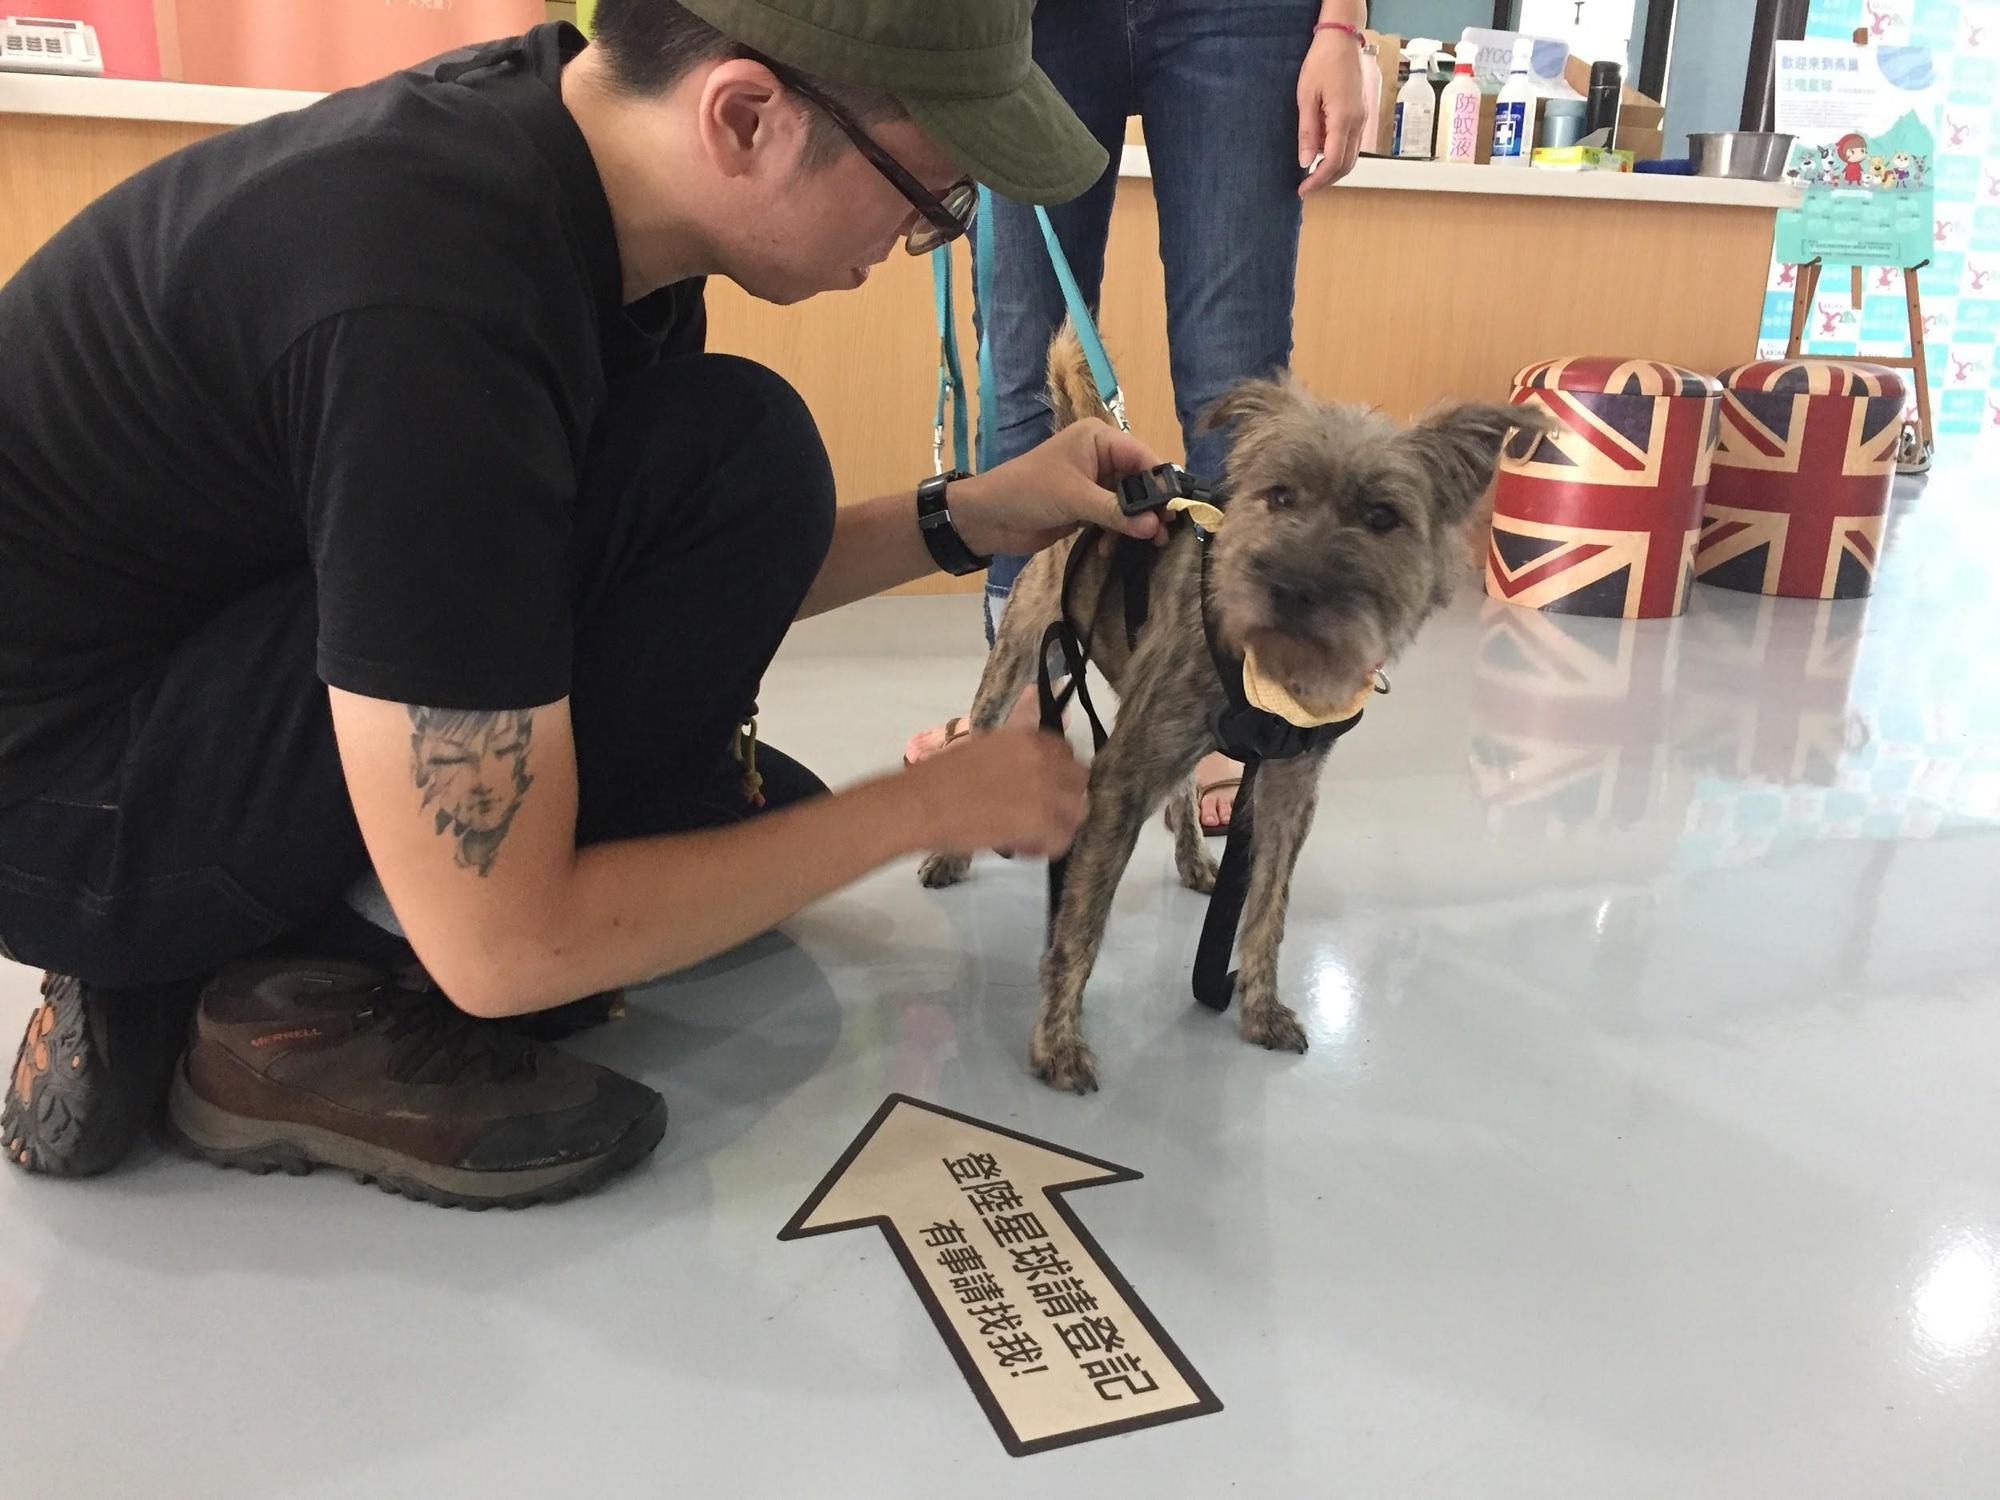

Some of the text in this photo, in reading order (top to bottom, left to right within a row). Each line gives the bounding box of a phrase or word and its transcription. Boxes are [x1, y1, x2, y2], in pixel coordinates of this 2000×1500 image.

[1450, 93, 1478, 157] 防蚊液
[920, 1219, 1049, 1378] 有事請找我!
[942, 1152, 1159, 1401] 登陸星球請登記
